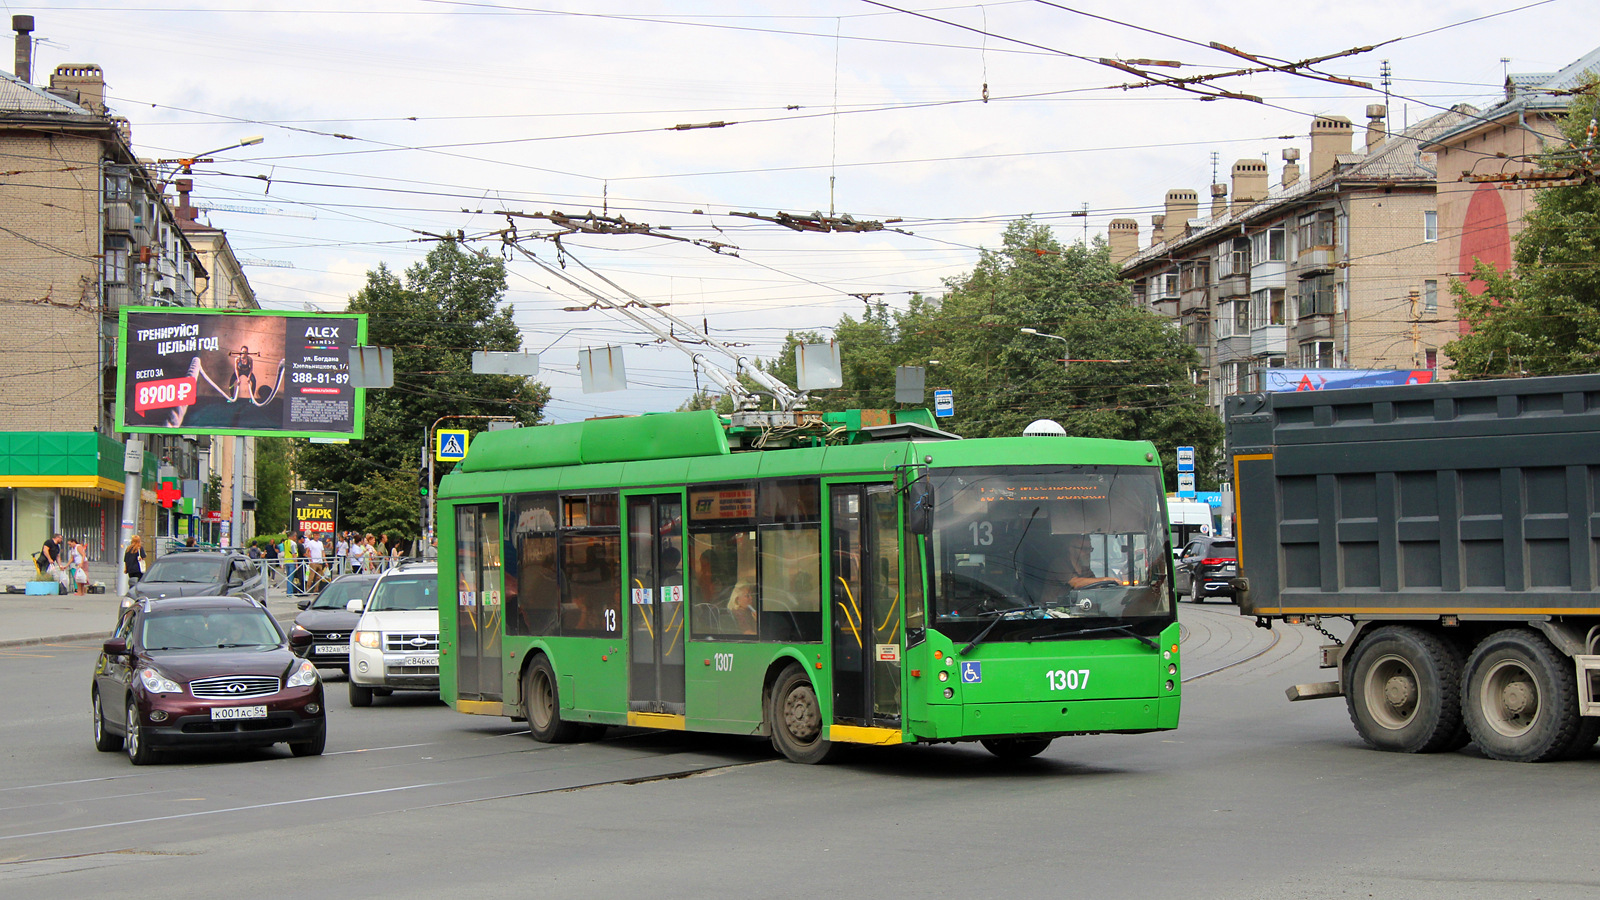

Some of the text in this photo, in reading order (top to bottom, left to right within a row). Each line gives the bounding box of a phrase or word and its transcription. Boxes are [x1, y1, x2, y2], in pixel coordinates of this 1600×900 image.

[137, 323, 199, 341] ТРЕНИРУЙСЯ
[304, 326, 340, 338] ALEX
[157, 336, 219, 356] ЦЕЛЫЙ ГОД
[313, 355, 339, 363] Богдана
[135, 368, 164, 379] ВСЕГО ЗА
[292, 372, 350, 384] 388-81-89
[139, 384, 176, 405] 8900
[296, 508, 332, 520] ЦИРК
[305, 521, 333, 532] ВОДЕ
[968, 521, 994, 546] 13
[604, 609, 616, 632] 13
[714, 653, 734, 672] 1307
[1045, 669, 1090, 690] 1307
[254, 706, 264, 714] 54
